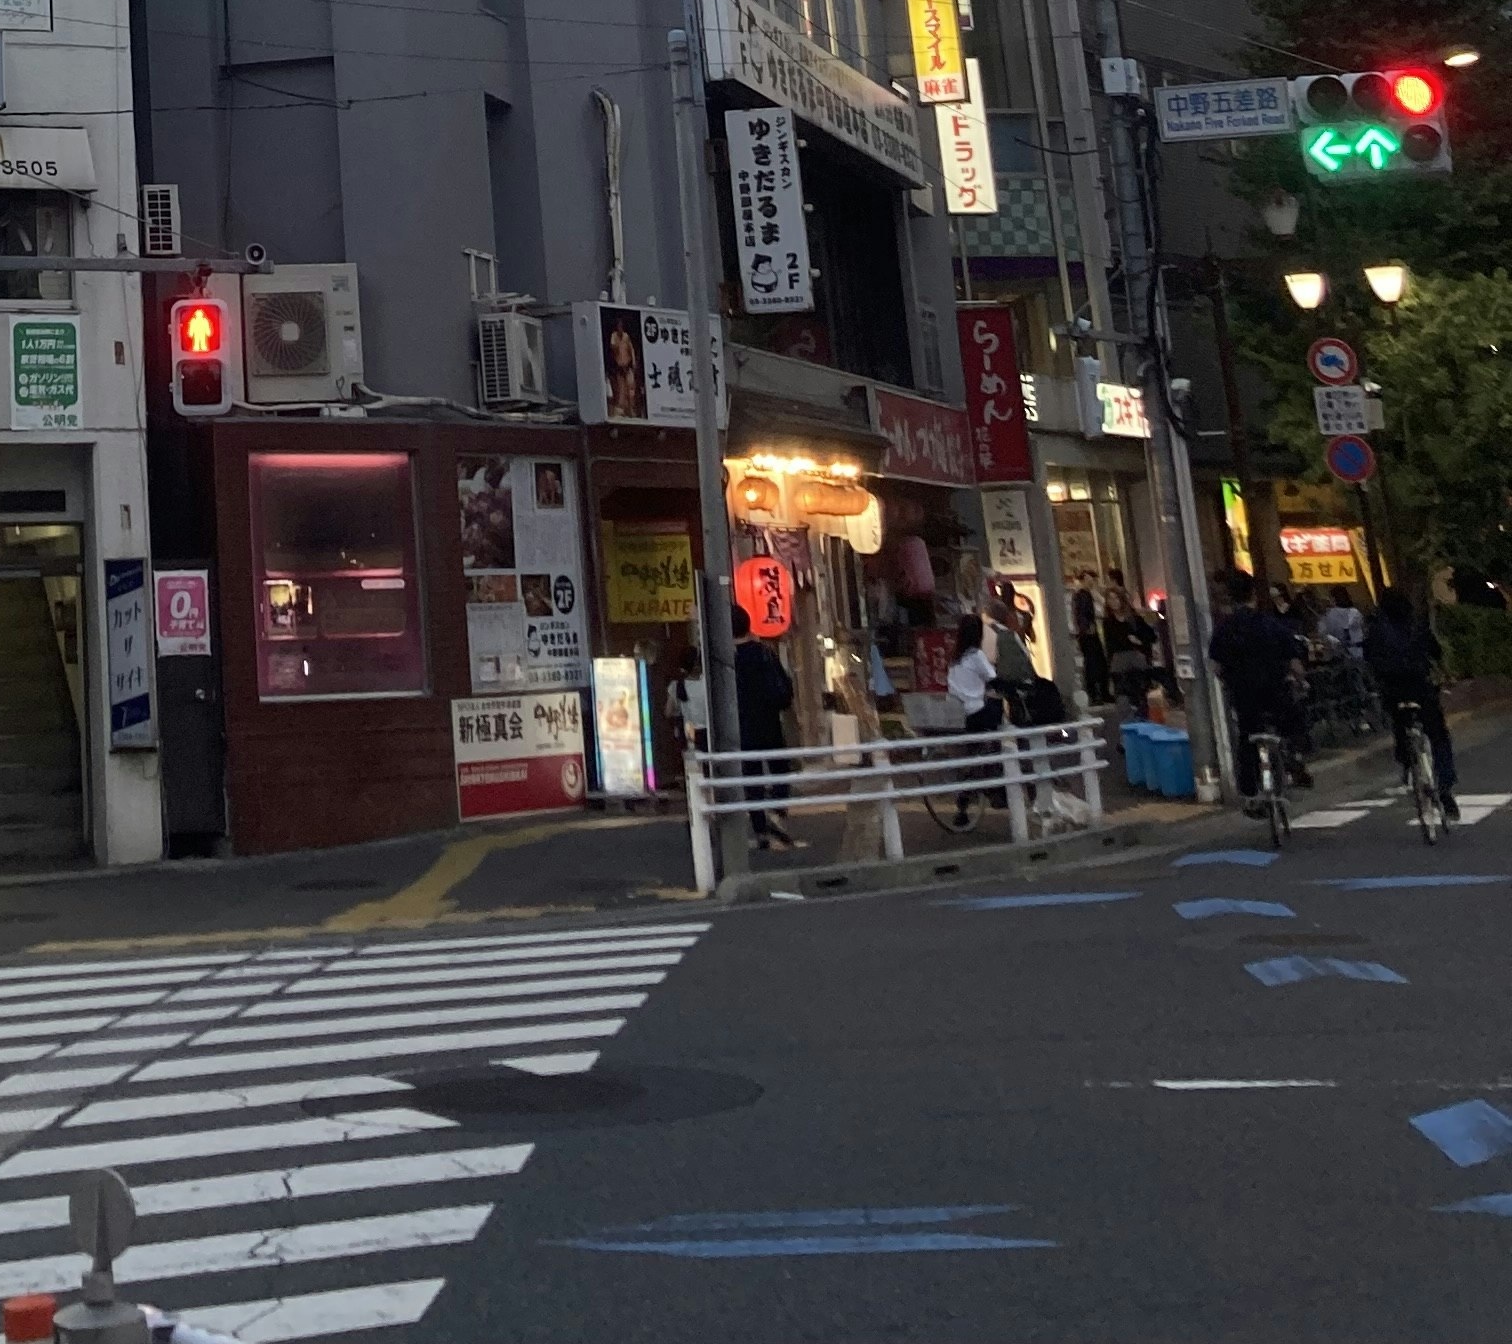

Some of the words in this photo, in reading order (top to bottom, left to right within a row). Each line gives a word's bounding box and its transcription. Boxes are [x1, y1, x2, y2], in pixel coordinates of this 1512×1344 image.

[924, 76, 961, 96] 麻雀
[1167, 87, 1280, 118] 中野五差路
[1166, 119, 1203, 132] Nakano
[951, 115, 984, 209] ドラッグ
[747, 117, 781, 246] ゆきだるま
[785, 252, 801, 290] 2F
[971, 319, 1014, 425] らーめん
[42, 414, 79, 428] 公明党
[998, 536, 1017, 559] 24
[1289, 560, 1354, 579] 方せん
[623, 598, 693, 617] KARATE
[458, 711, 524, 744] 新極真会
